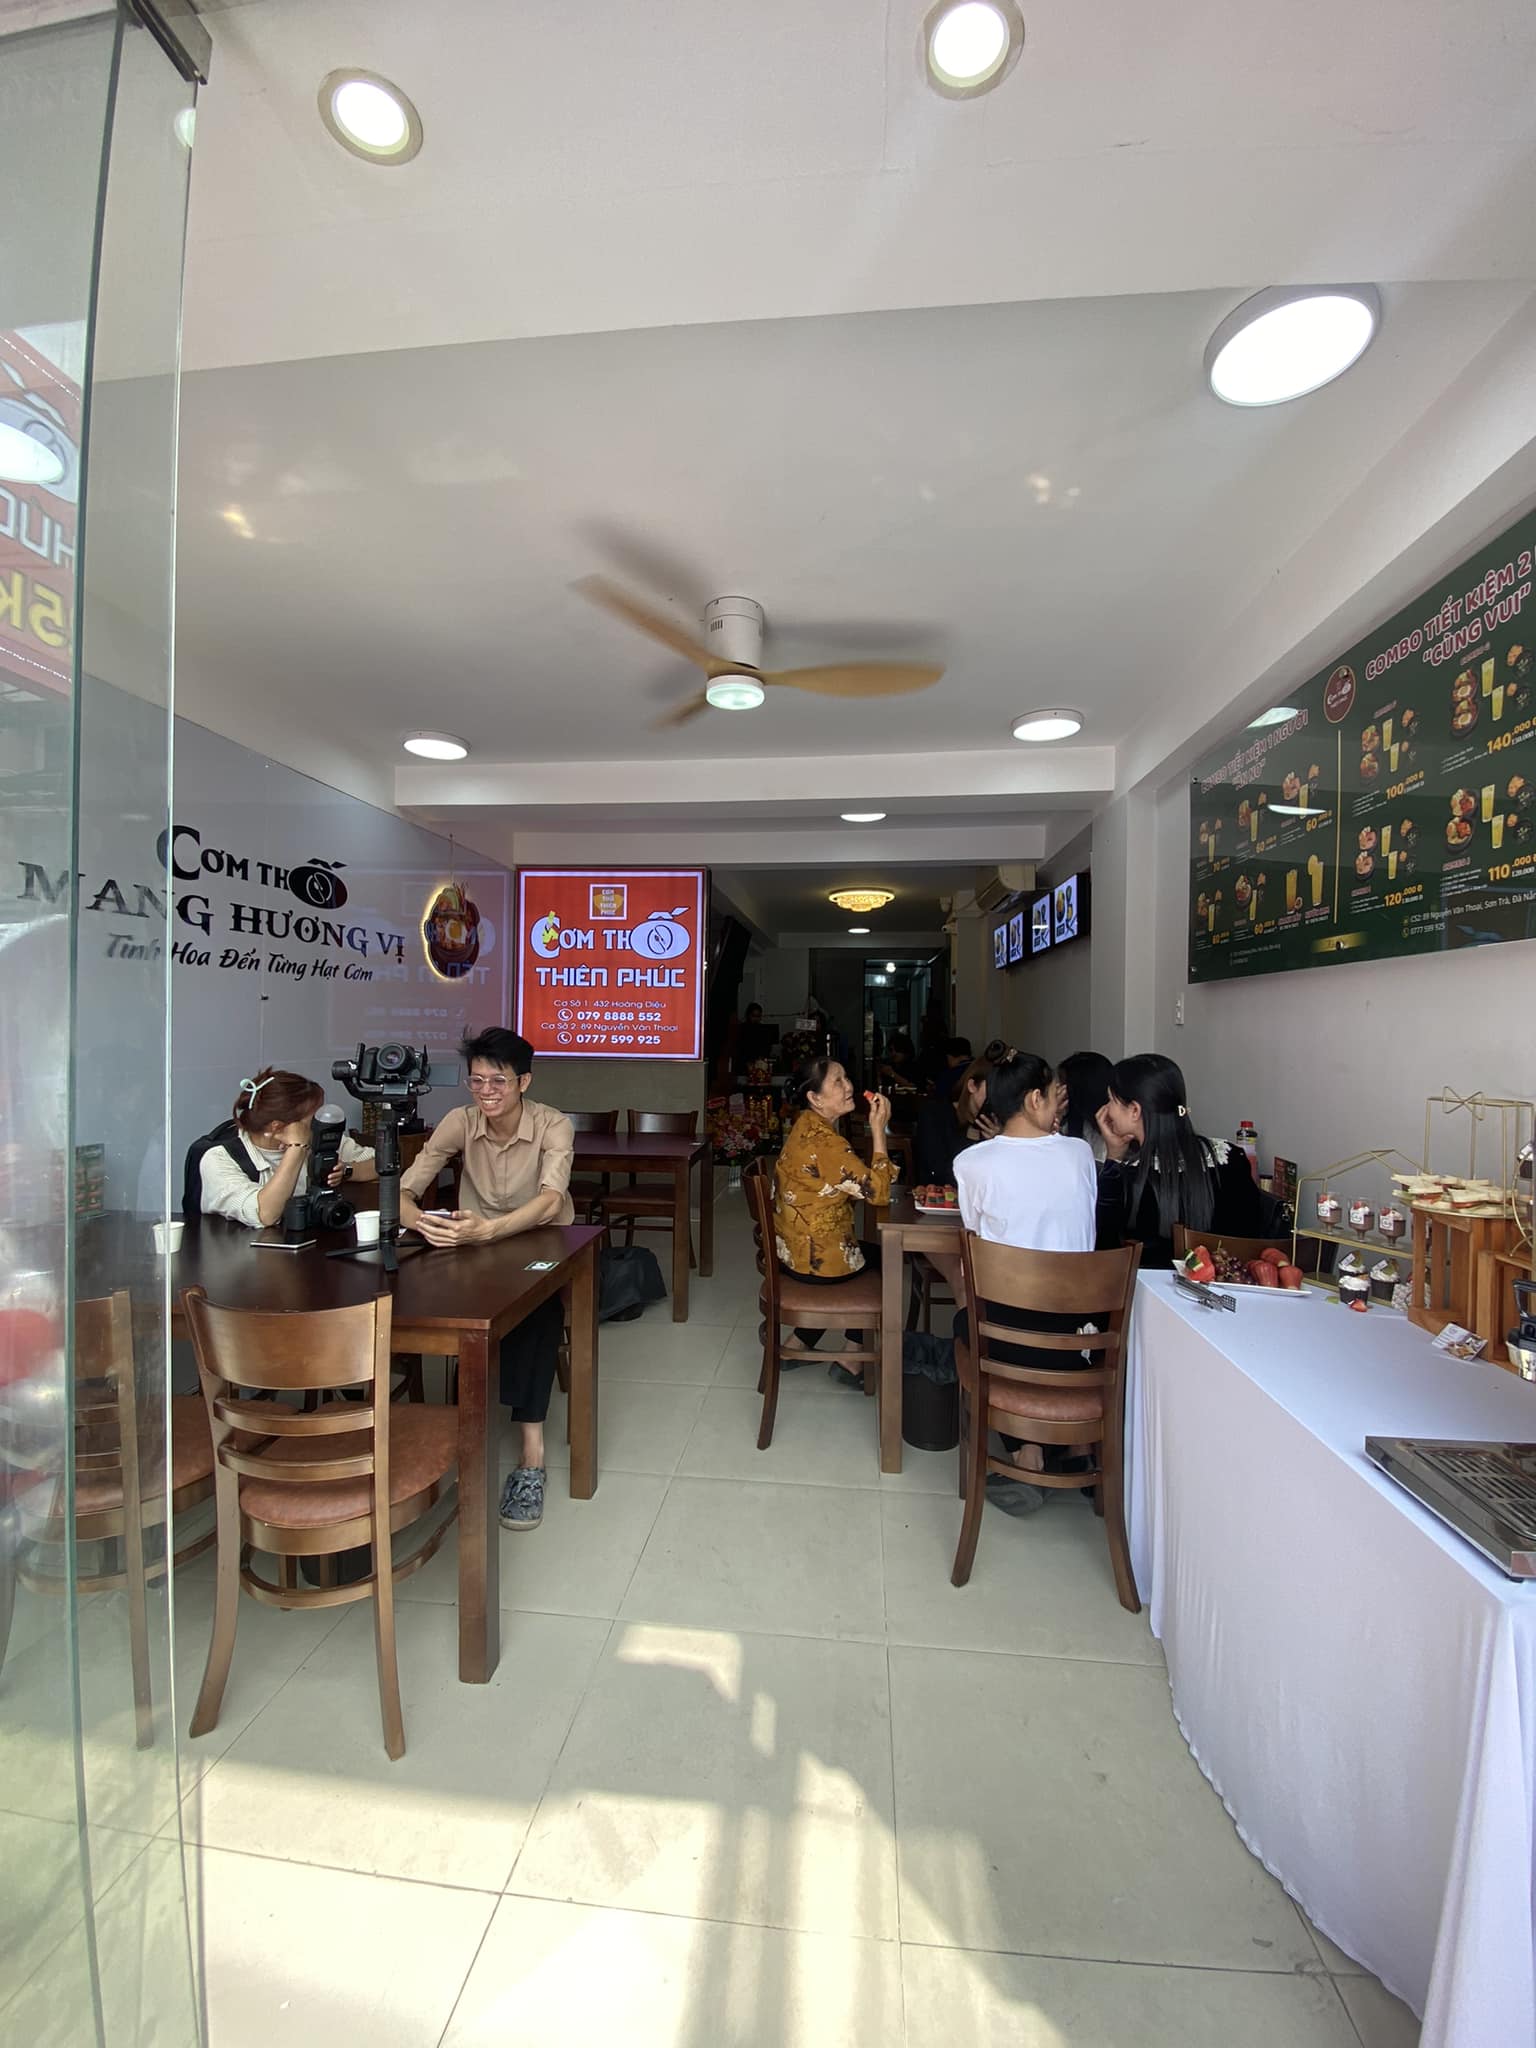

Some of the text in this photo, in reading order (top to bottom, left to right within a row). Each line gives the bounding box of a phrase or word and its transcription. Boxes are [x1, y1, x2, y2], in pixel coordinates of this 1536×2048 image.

[1366, 629, 1423, 680] COMBO
[1424, 595, 1463, 641] TIẾT
[1465, 562, 1515, 614] KIỆM
[1517, 551, 1532, 578] 2
[156, 825, 249, 881] CƠM
[17, 861, 405, 964] MANG HƯƠNG VỊ
[1484, 898, 1498, 909] Sơn
[1512, 893, 1522, 904] Đà
[530, 911, 595, 959] CƠM
[171, 941, 211, 965] Hoa
[218, 947, 260, 971] Đến
[268, 952, 307, 981] Từng
[311, 958, 339, 980] Hạt
[344, 963, 373, 981] Cơm
[535, 964, 686, 988] THIÊN PHÚC
[577, 1011, 661, 1021] 079 8888 552
[593, 1000, 610, 1008] 432
[576, 1034, 661, 1044] 0777 599 925
